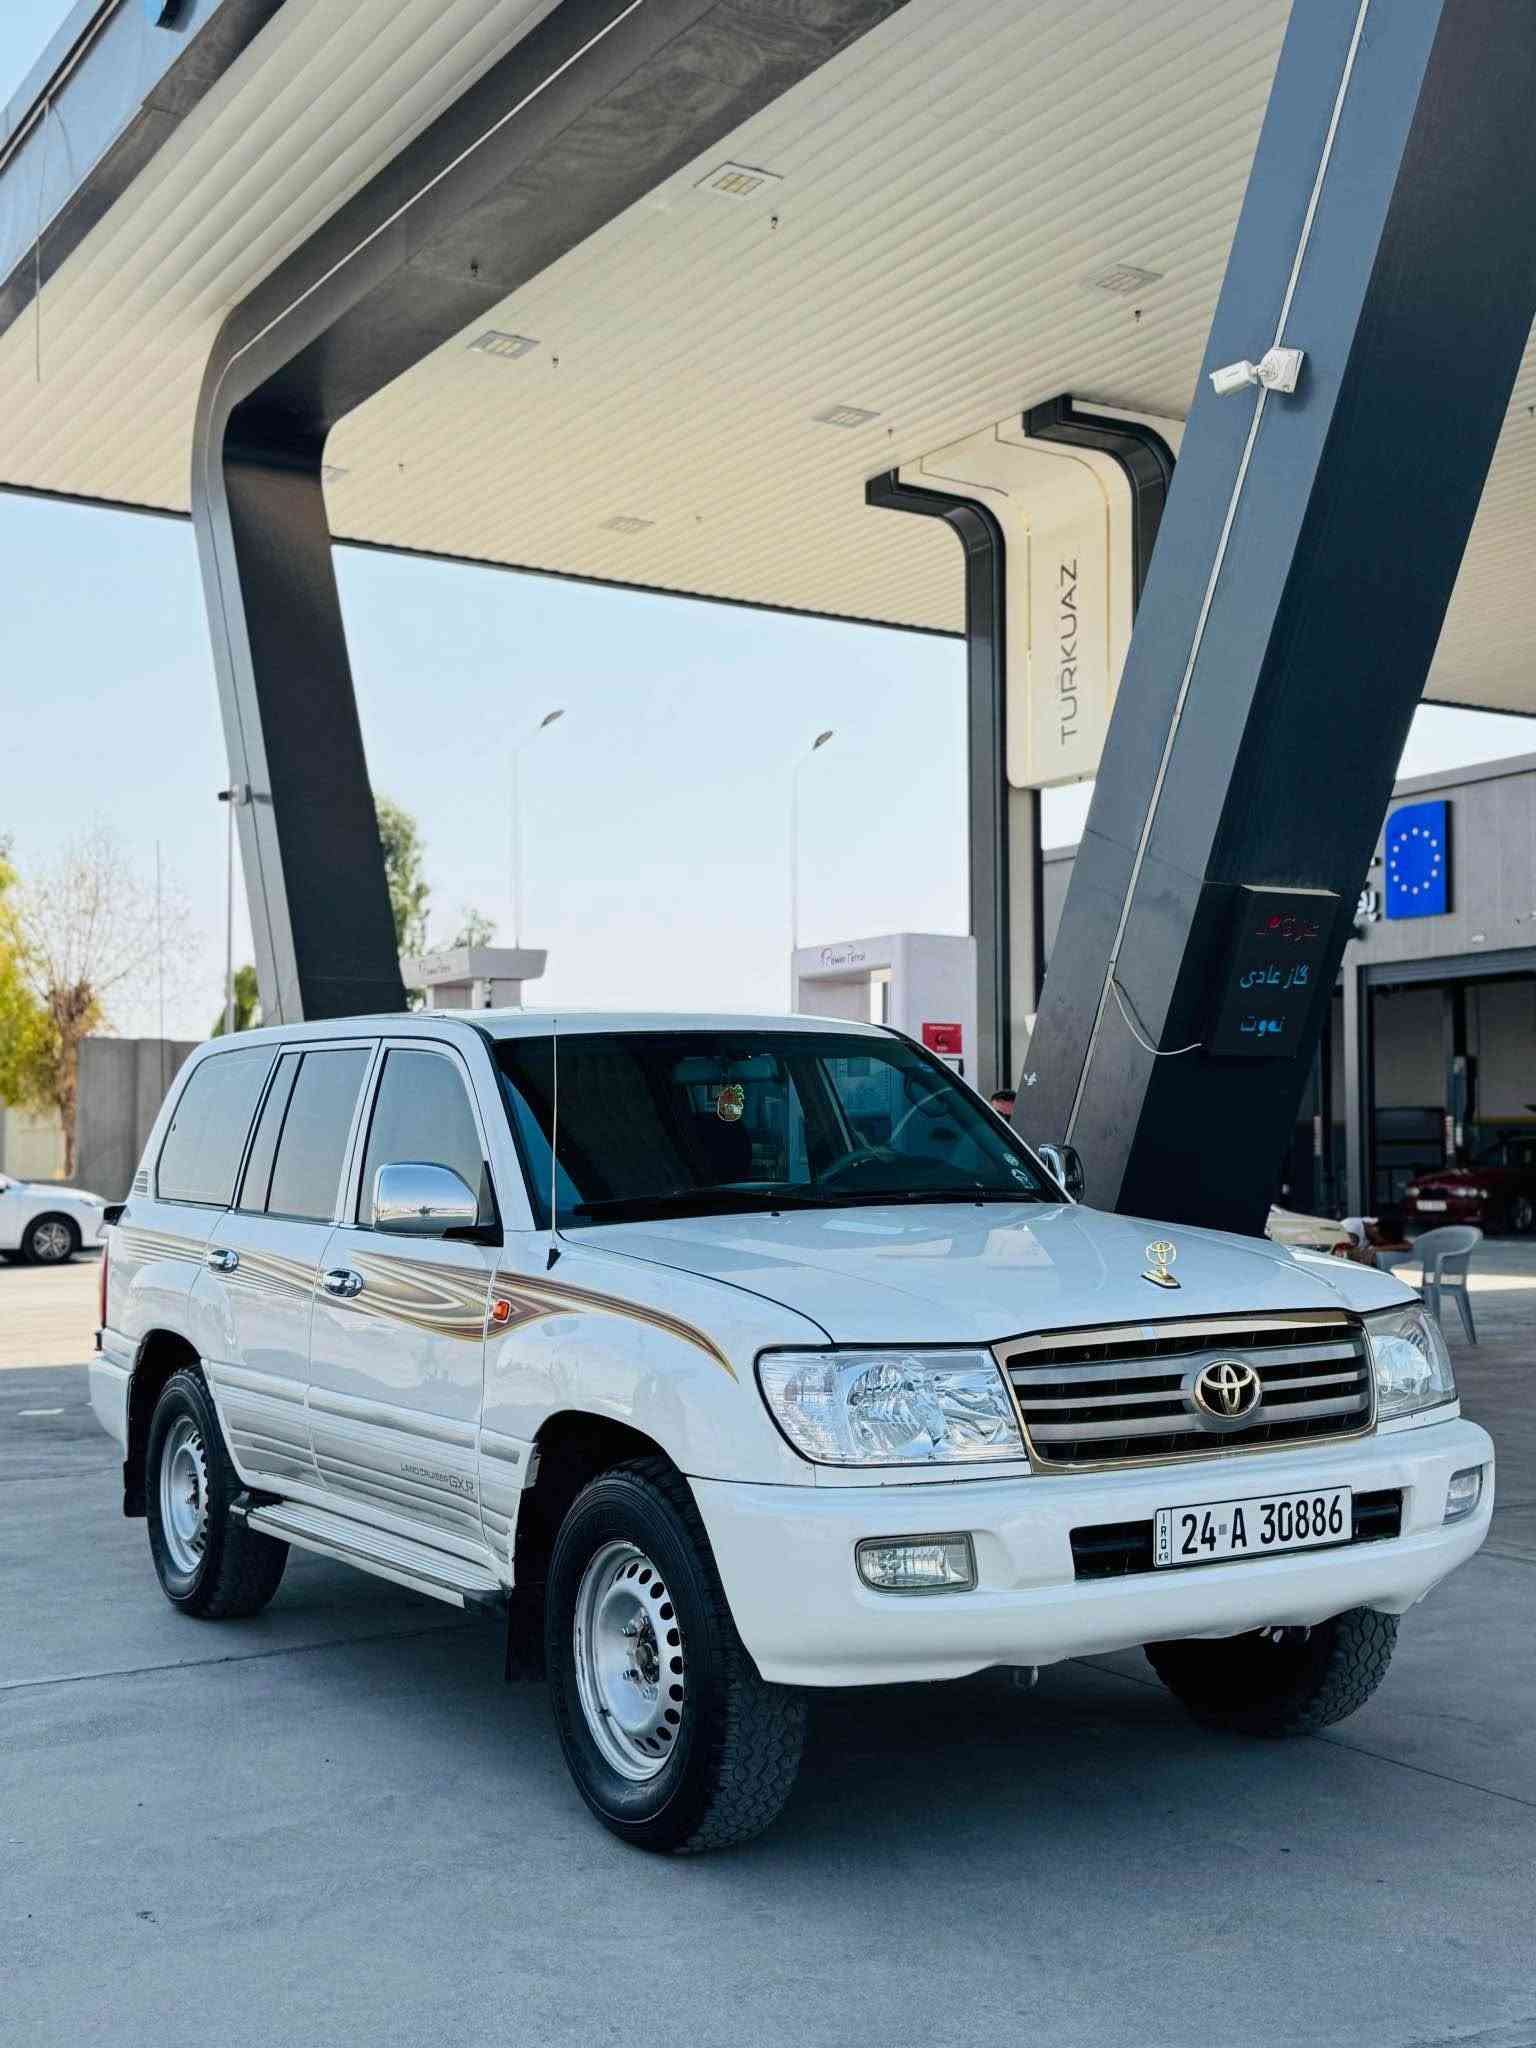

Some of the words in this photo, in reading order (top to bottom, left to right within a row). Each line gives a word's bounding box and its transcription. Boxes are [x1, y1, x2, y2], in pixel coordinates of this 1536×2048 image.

[1060, 559, 1078, 745] TURKUAZ
[1181, 1511, 1217, 1555] 24
[1231, 1507, 1247, 1548] A
[1260, 1494, 1343, 1544] 30886
